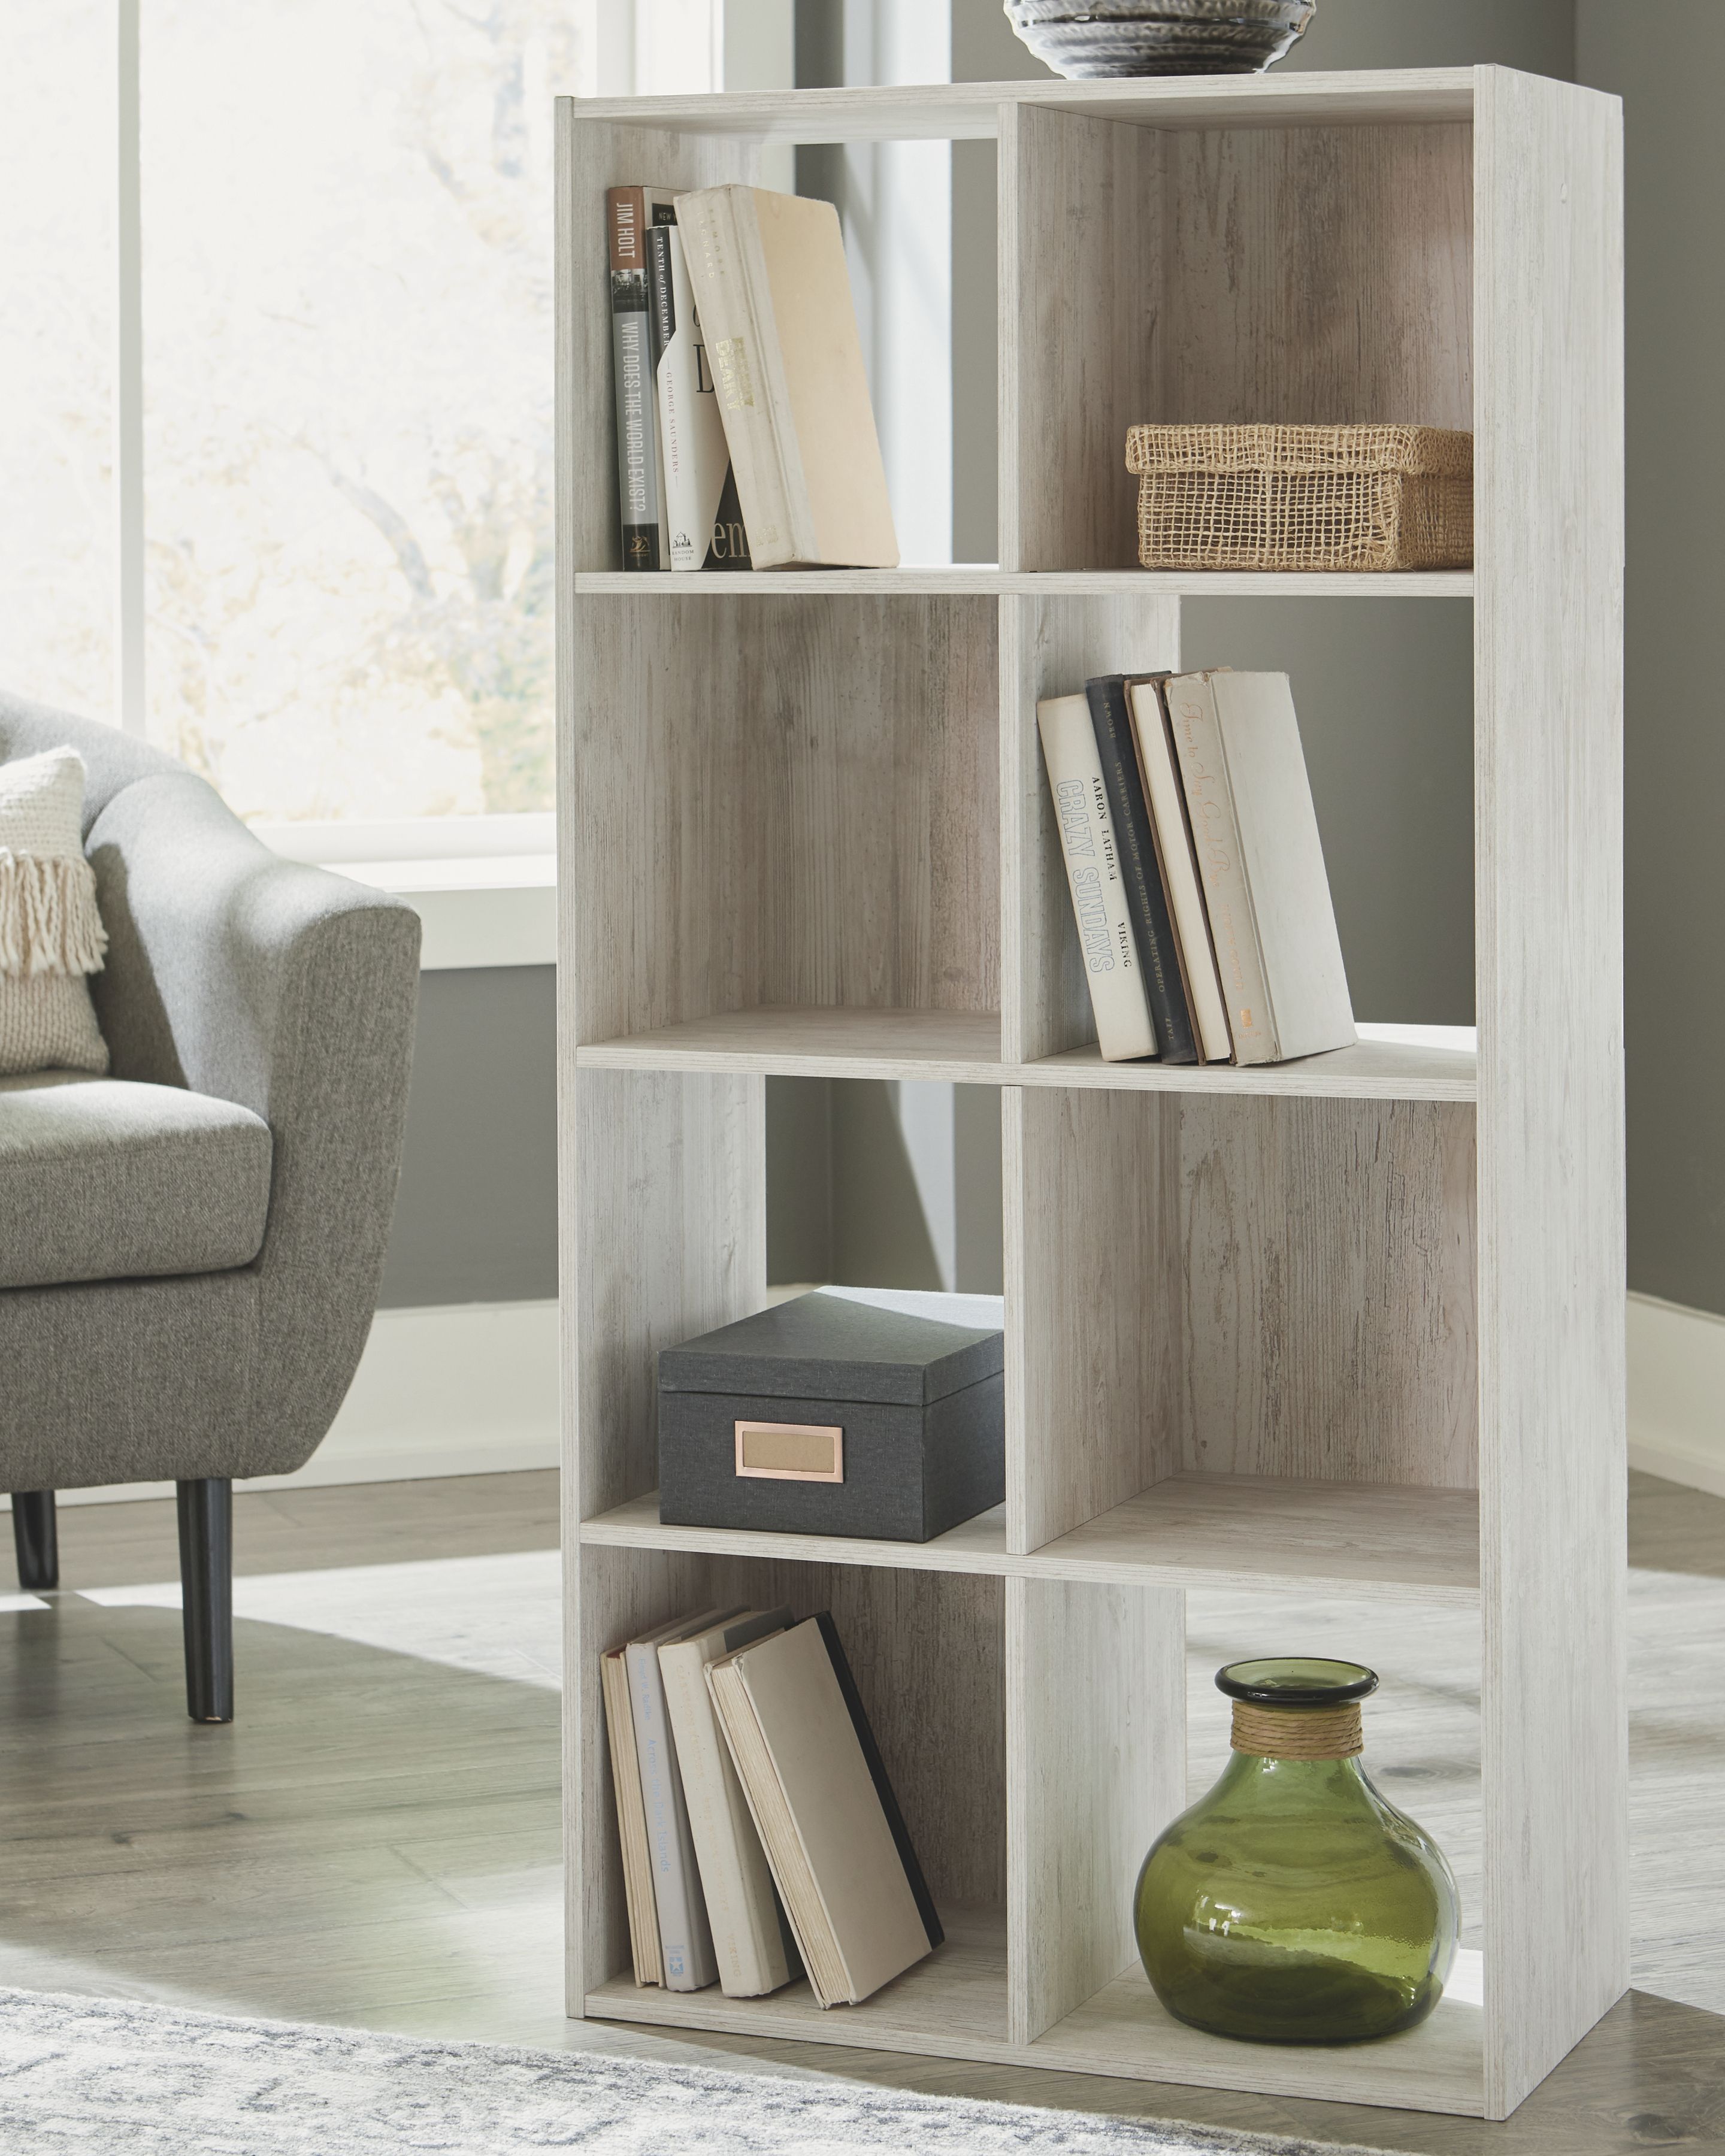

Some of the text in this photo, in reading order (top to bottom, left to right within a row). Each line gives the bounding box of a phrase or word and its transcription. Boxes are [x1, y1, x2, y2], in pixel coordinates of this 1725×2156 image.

[616, 203, 635, 258] JIM HOLT
[659, 212, 671, 221] NEW
[656, 237, 670, 347] TENTH of DECEMBER
[621, 321, 646, 512] WHY DOES THE WORLD EXIST?
[666, 372, 679, 473] GEORGE SAUNDERS
[1103, 702, 1116, 738] BROWN
[1179, 702, 1203, 743] Time
[1188, 746, 1199, 758] to
[1091, 777, 1117, 881] AARON LATHAM
[1056, 780, 1115, 973] CRAZY SUNDAYS
[1115, 761, 1165, 993] OPERATING RIGHTS OF MOTOR CARRIERS
[1117, 922, 1132, 968] VIKING
[647, 1739, 671, 1873] Across the Dark Islands
[727, 1933, 742, 1978] VIKING
